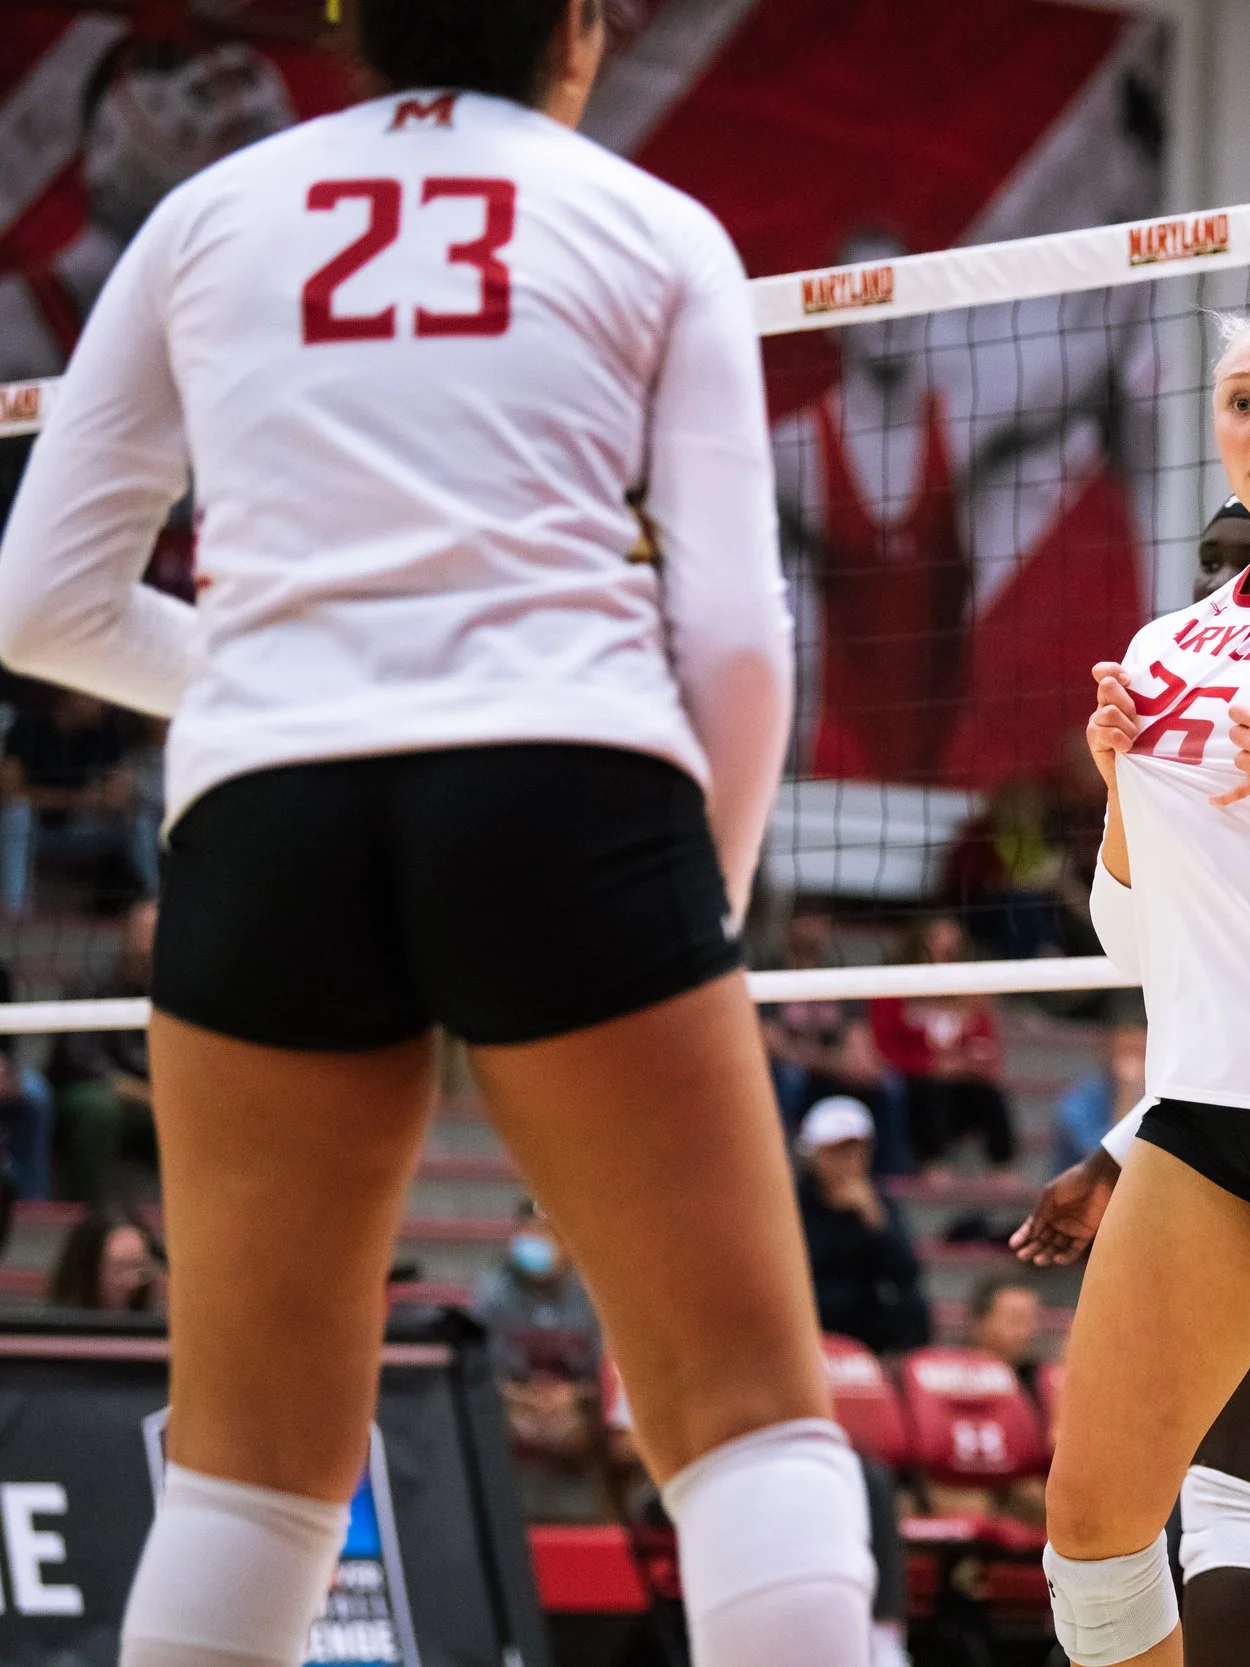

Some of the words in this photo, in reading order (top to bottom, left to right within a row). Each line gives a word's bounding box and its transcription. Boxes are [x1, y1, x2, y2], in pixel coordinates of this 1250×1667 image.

[386, 96, 455, 132] M
[302, 177, 516, 345] 23
[1129, 214, 1228, 256] MARYLAND
[802, 267, 893, 305] MARYLAND
[1126, 660, 1240, 766] 26
[0, 1481, 85, 1617] E
